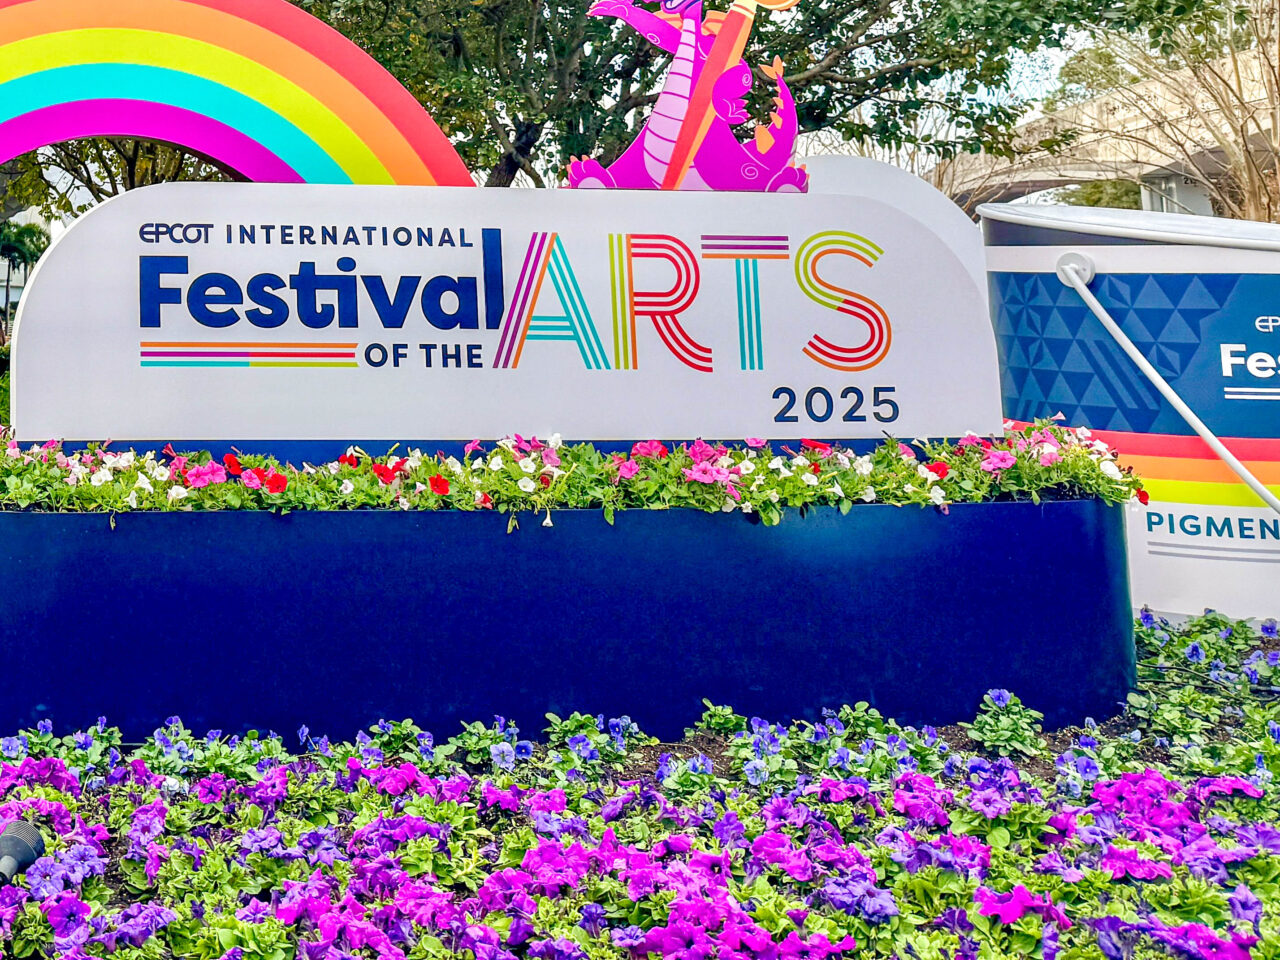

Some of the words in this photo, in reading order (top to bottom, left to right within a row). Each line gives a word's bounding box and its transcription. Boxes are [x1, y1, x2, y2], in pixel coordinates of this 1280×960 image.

[138, 223, 214, 244] EPCOT
[226, 224, 474, 248] INTERNATIONAL
[139, 228, 504, 330] Festival
[492, 229, 892, 373] ARTS
[364, 343, 409, 368] OF
[420, 343, 483, 368] THE
[1220, 343, 1280, 378] Fe
[771, 386, 900, 423] 2025
